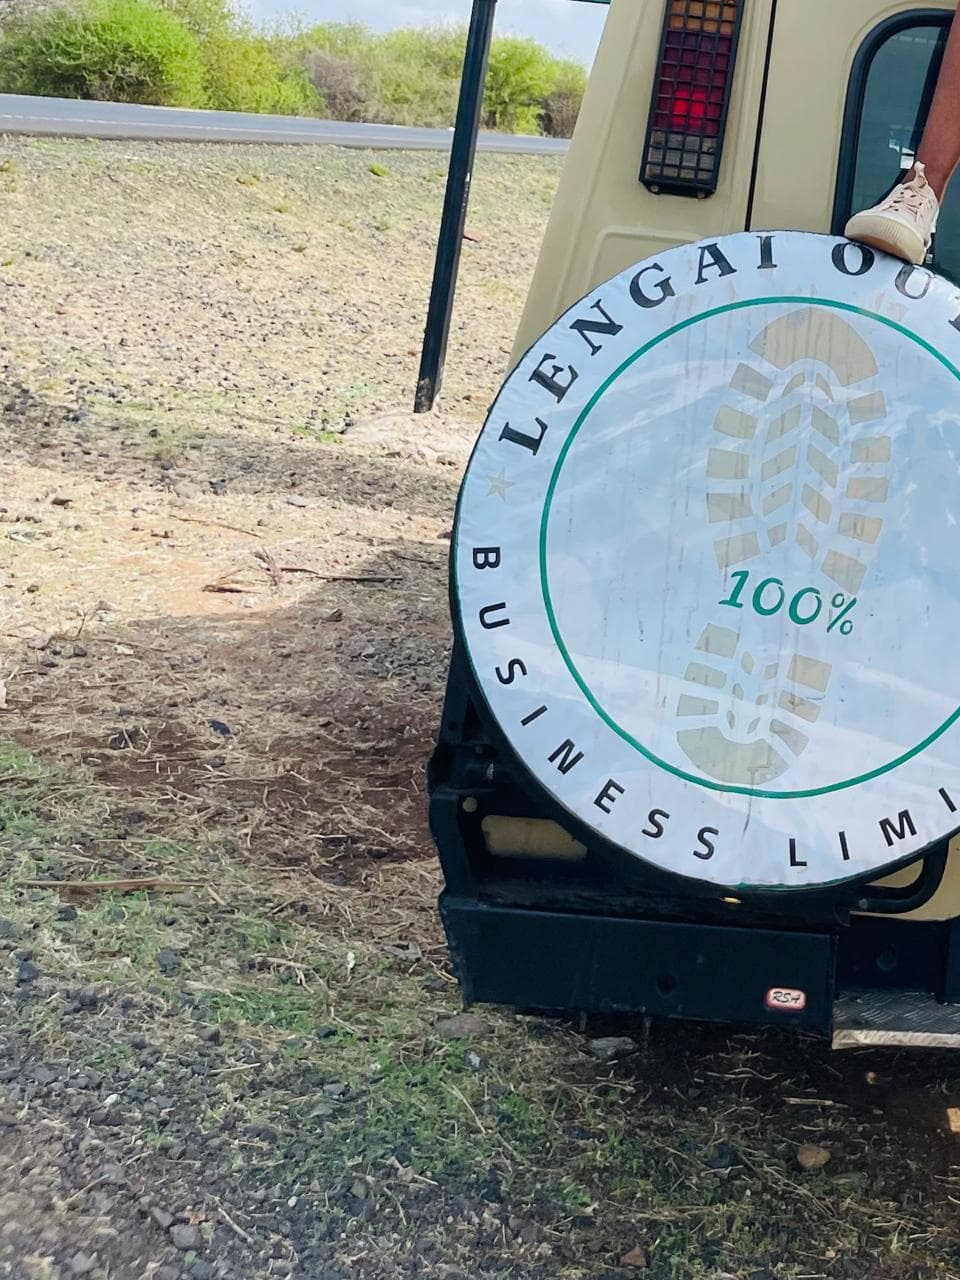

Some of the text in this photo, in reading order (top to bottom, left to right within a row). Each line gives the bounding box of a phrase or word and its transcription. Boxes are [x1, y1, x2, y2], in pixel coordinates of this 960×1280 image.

[498, 235, 778, 456] LENGAI
[718, 569, 860, 636] 100%
[473, 546, 720, 861] BUSINESS
[773, 991, 800, 1003] RSA
